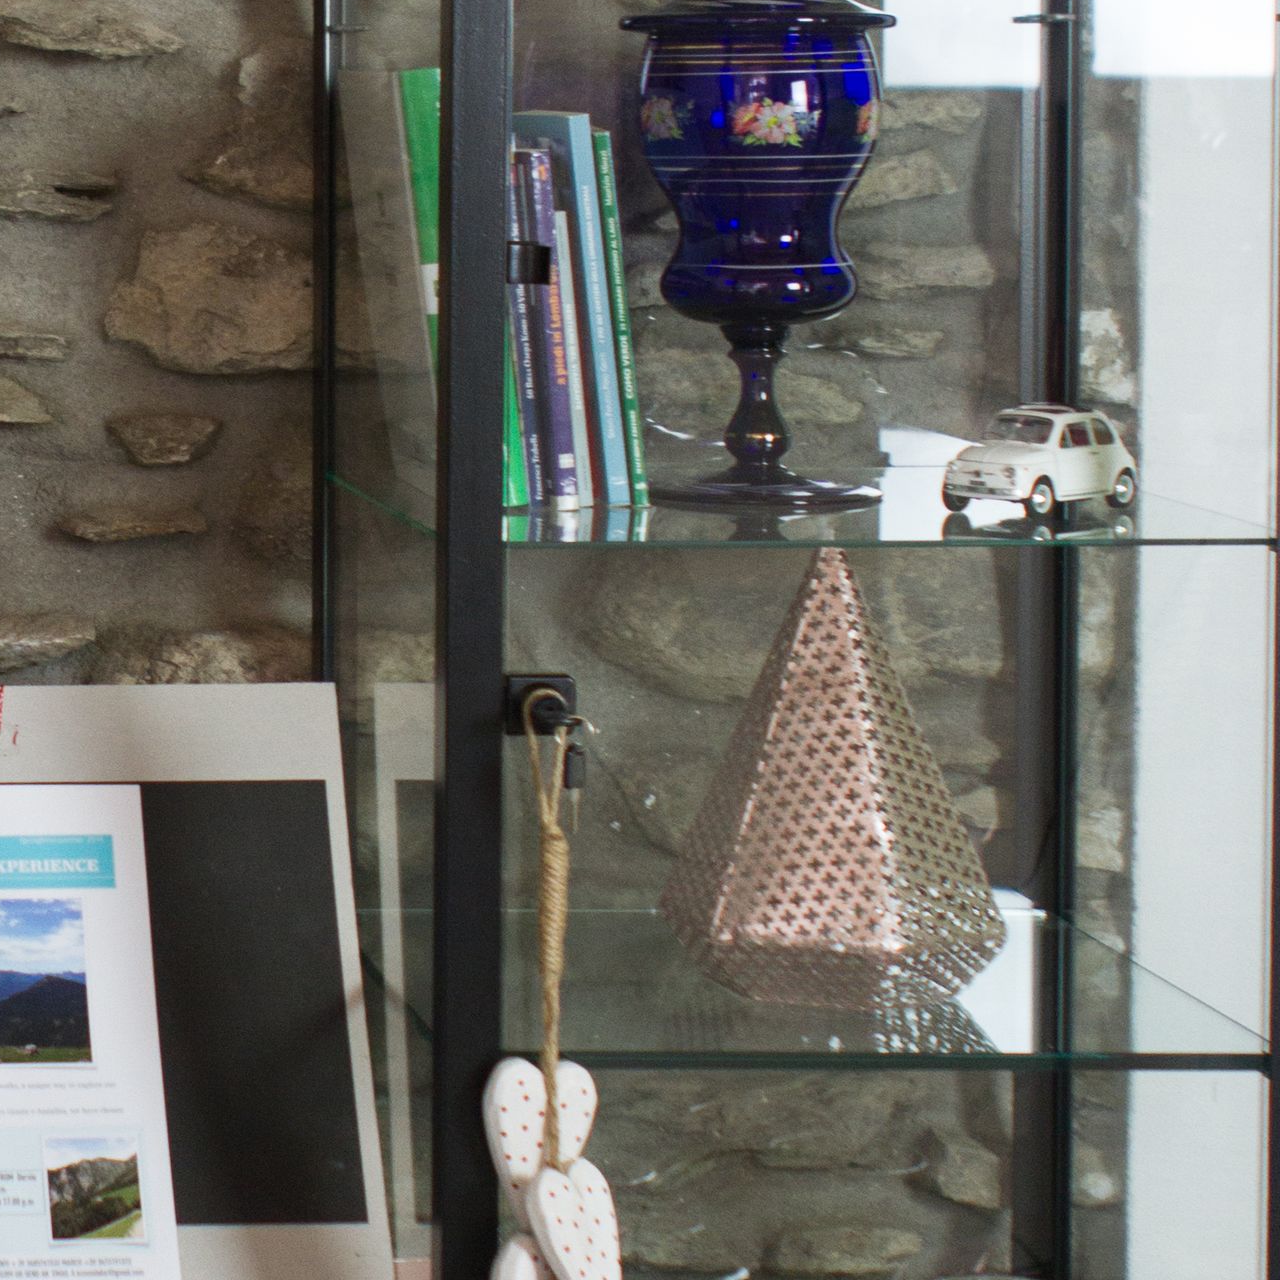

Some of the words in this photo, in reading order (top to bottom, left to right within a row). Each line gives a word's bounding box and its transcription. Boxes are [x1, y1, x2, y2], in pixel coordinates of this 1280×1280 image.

[552, 345, 567, 375] piedi
[620, 335, 631, 366] VERDE
[623, 368, 634, 399] COMO
